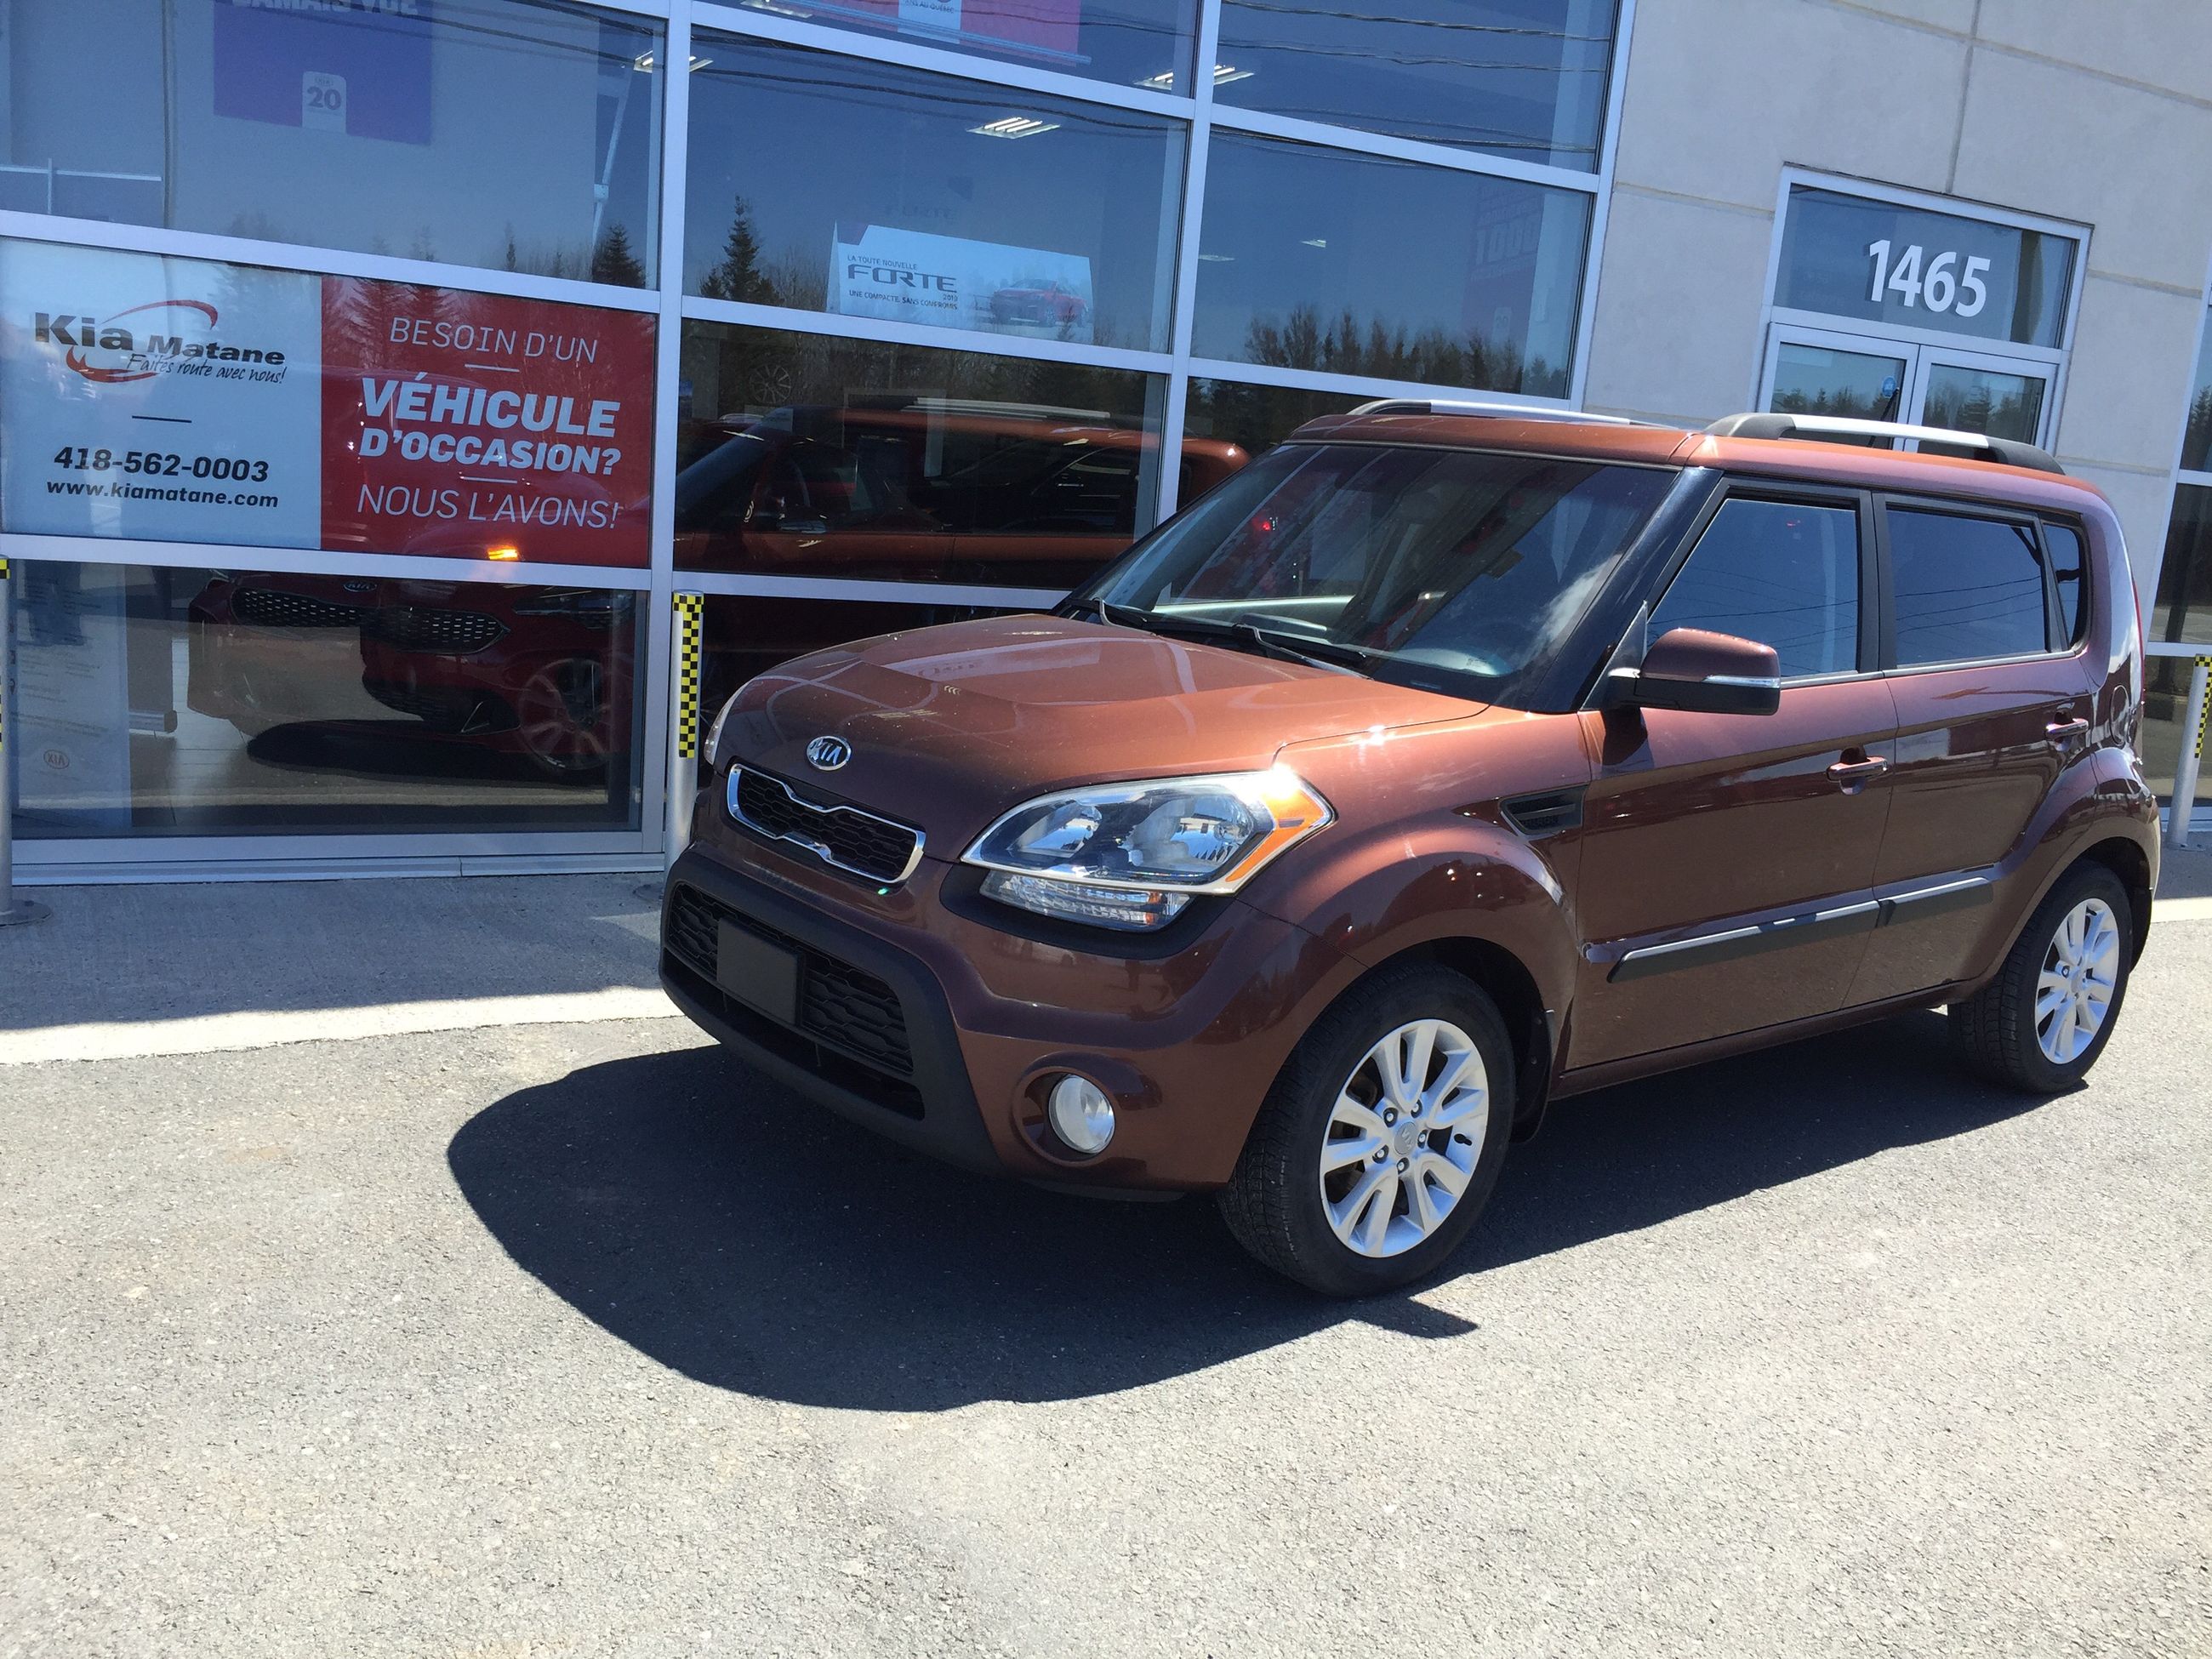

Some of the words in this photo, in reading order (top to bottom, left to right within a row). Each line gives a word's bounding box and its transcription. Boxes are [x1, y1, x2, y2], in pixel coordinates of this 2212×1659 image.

[307, 86, 341, 111] 20
[847, 264, 958, 294] FORTE
[858, 256, 881, 265] TOUTE
[882, 259, 918, 271] NOUVELLE
[1869, 239, 1991, 317] 1465
[849, 289, 863, 299] UNE
[902, 297, 919, 305] SANS
[921, 299, 958, 311] COMPROMIS
[35, 311, 134, 351] Kia
[146, 334, 286, 365] Matane
[390, 316, 516, 355] BESOIN
[525, 331, 597, 363] D'UN
[127, 353, 174, 374] Faites
[177, 361, 213, 377] route
[215, 366, 245, 380] avec
[249, 366, 288, 384] nous!
[362, 372, 620, 438] VÉHICULE
[54, 447, 270, 482] 418-562-0003
[359, 427, 621, 476] D'OCCASION?
[47, 481, 278, 508] www.kiamatane.com
[357, 483, 459, 519] NOUS
[468, 492, 619, 529] L'AVONS!
[808, 738, 843, 767] KIA
